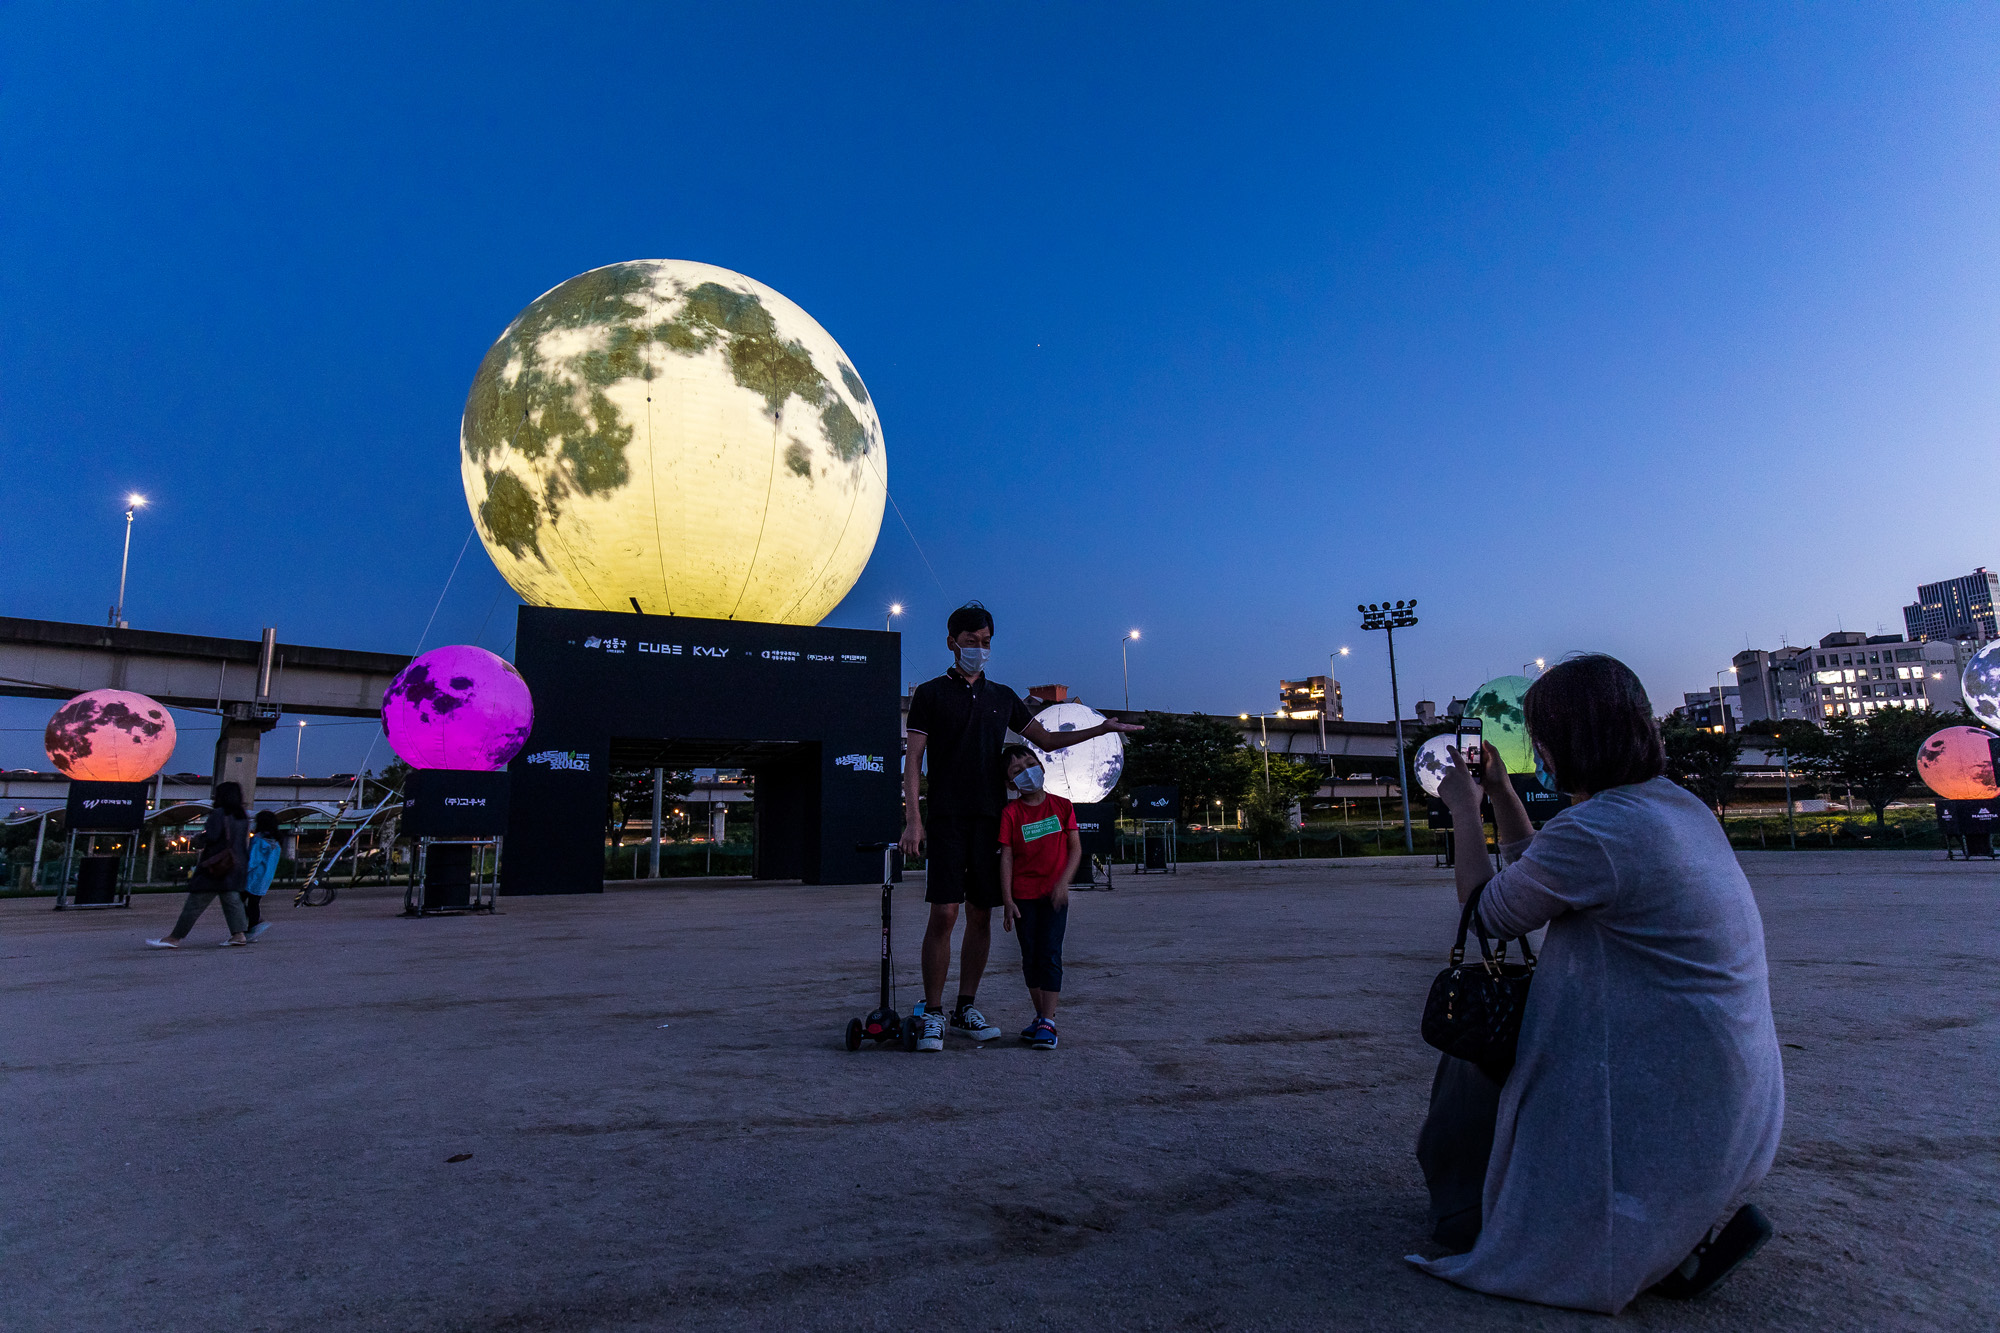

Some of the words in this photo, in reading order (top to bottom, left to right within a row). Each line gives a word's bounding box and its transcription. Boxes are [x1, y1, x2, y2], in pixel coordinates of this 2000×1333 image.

[603, 638, 627, 649] 성동구
[638, 642, 682, 655] CUBE
[807, 654, 835, 662] (주)고우넷
[444, 797, 486, 806] (주)고우넷
[1031, 826, 1053, 834] BENETTON
